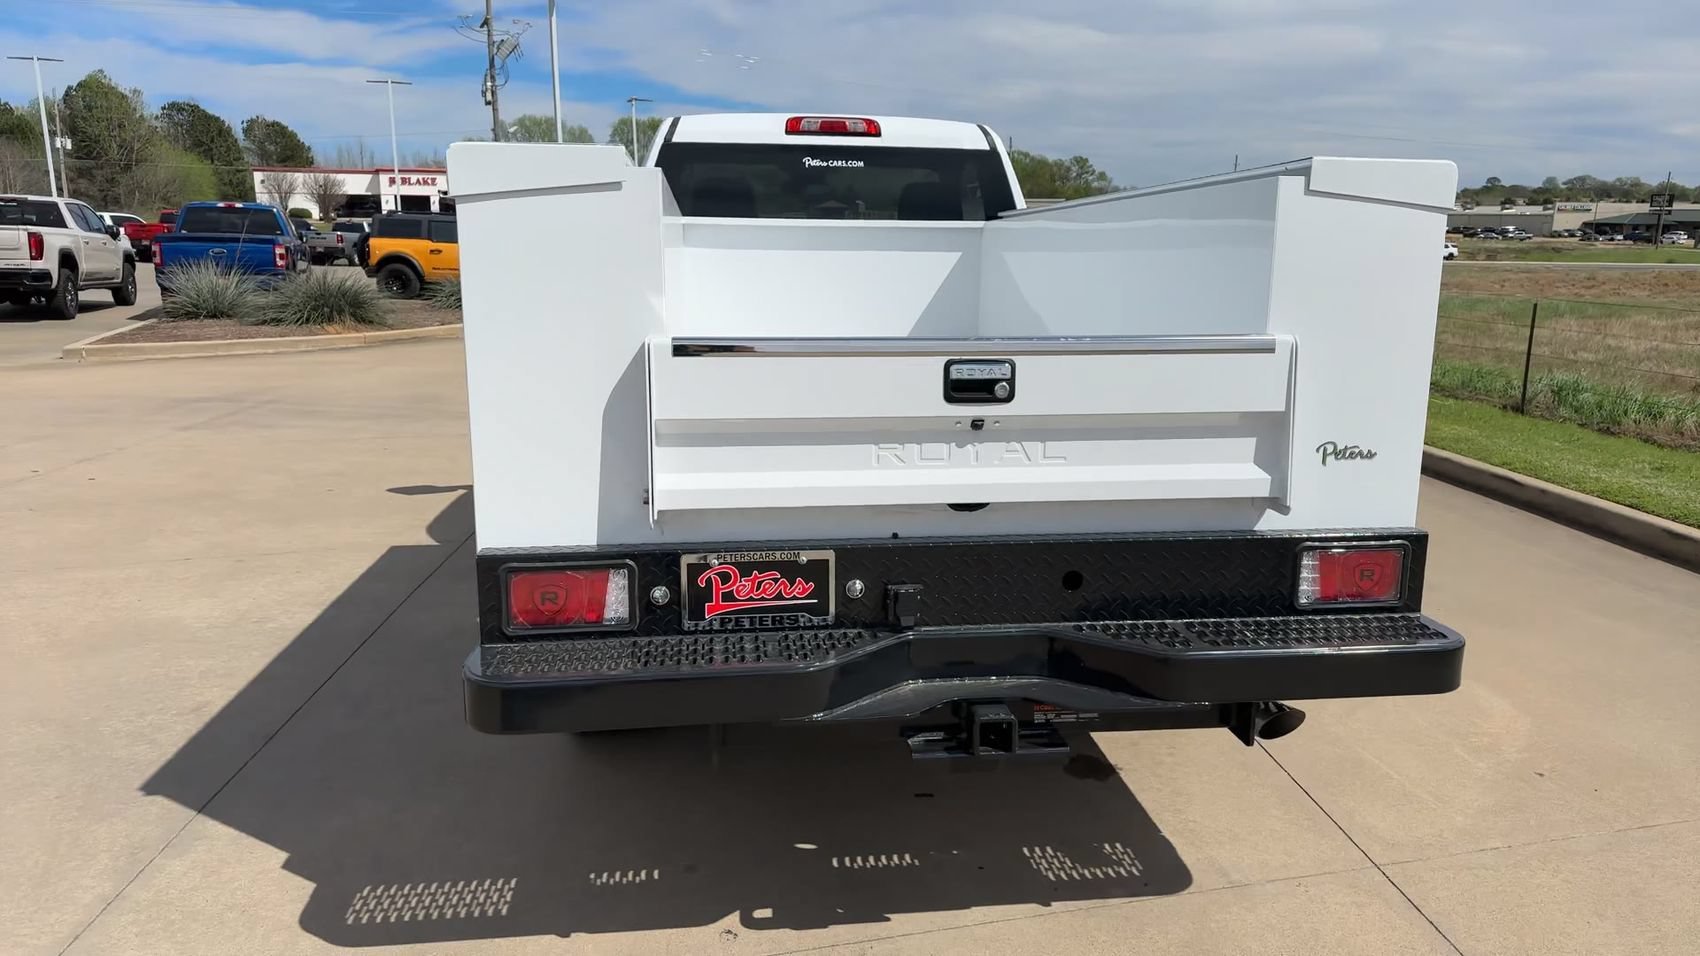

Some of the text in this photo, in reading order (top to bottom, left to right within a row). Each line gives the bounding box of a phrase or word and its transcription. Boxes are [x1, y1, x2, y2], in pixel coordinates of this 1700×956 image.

[802, 156, 828, 168] Peters
[400, 176, 437, 186] BLAKE
[953, 368, 1008, 376] ROYAL
[872, 441, 1067, 465] ROYAL
[1315, 440, 1378, 467] Peters
[717, 551, 800, 562] PETERSCARS.COM
[698, 564, 815, 611] Peters
[719, 614, 800, 628] PETERS
